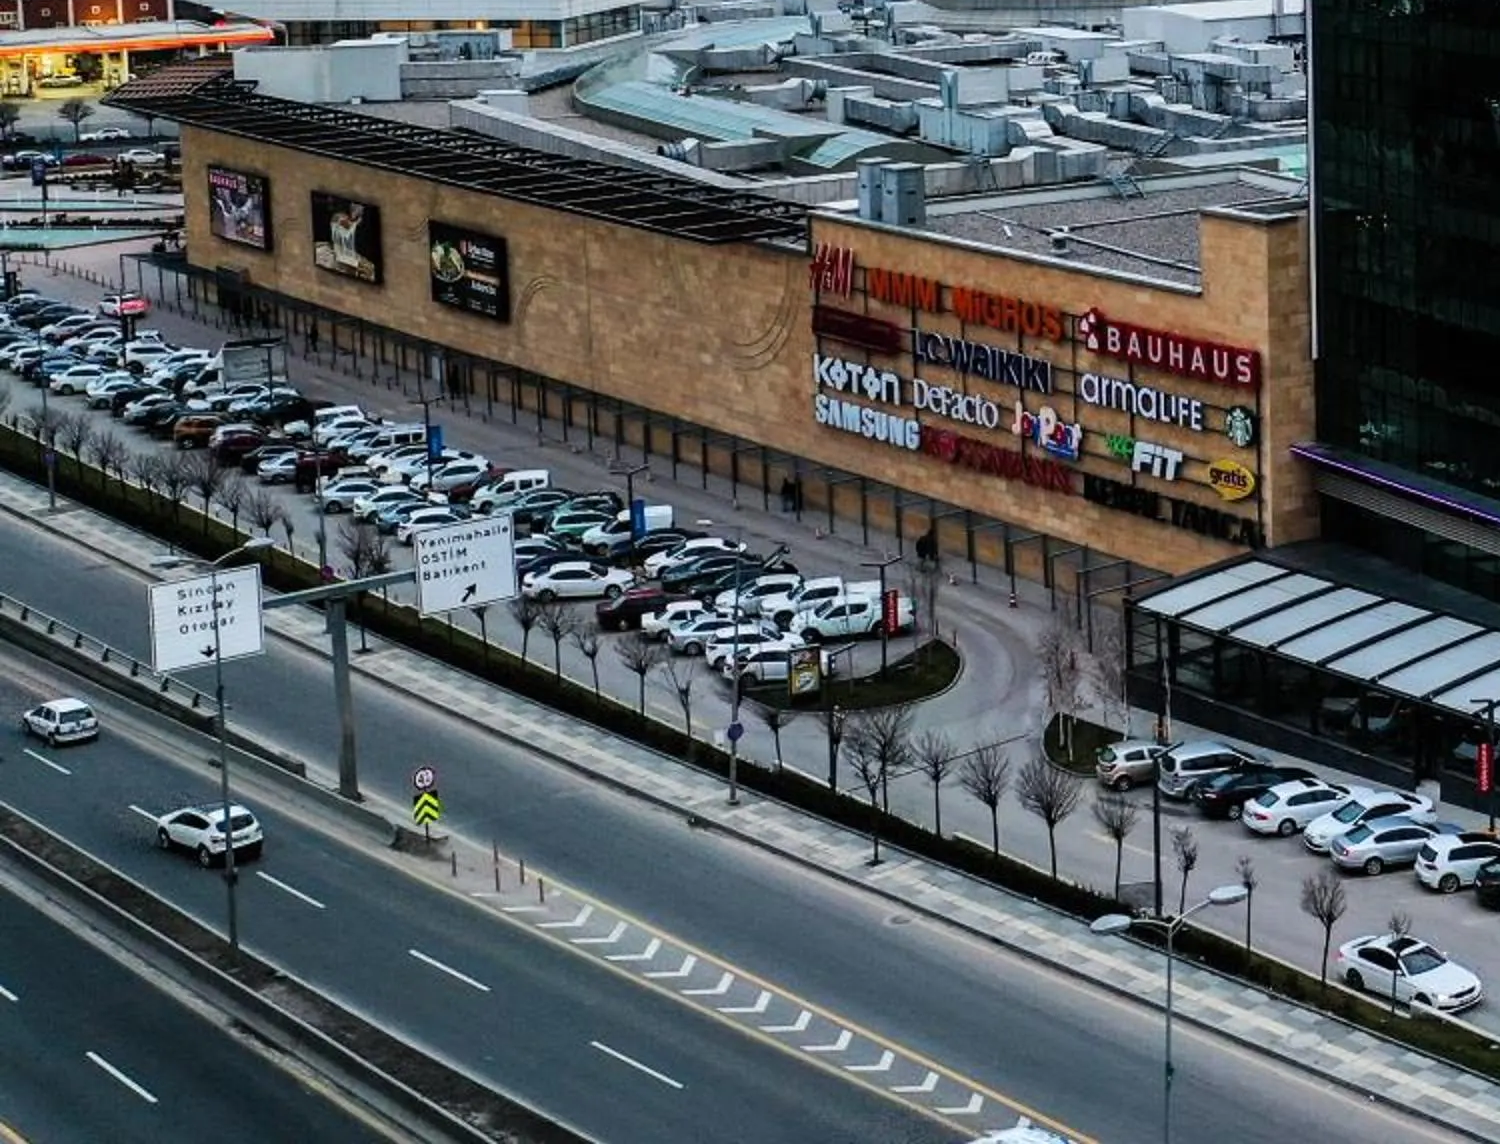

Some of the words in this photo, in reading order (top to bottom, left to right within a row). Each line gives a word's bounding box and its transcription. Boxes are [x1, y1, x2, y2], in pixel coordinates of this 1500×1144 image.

[868, 267, 942, 313] MMM
[1106, 326, 1252, 384] BAUHAUS
[814, 393, 922, 452] SAMSUNG
[912, 377, 999, 431] DeFacto
[1080, 372, 1203, 432] armaLIFE
[1209, 466, 1248, 490] gratis
